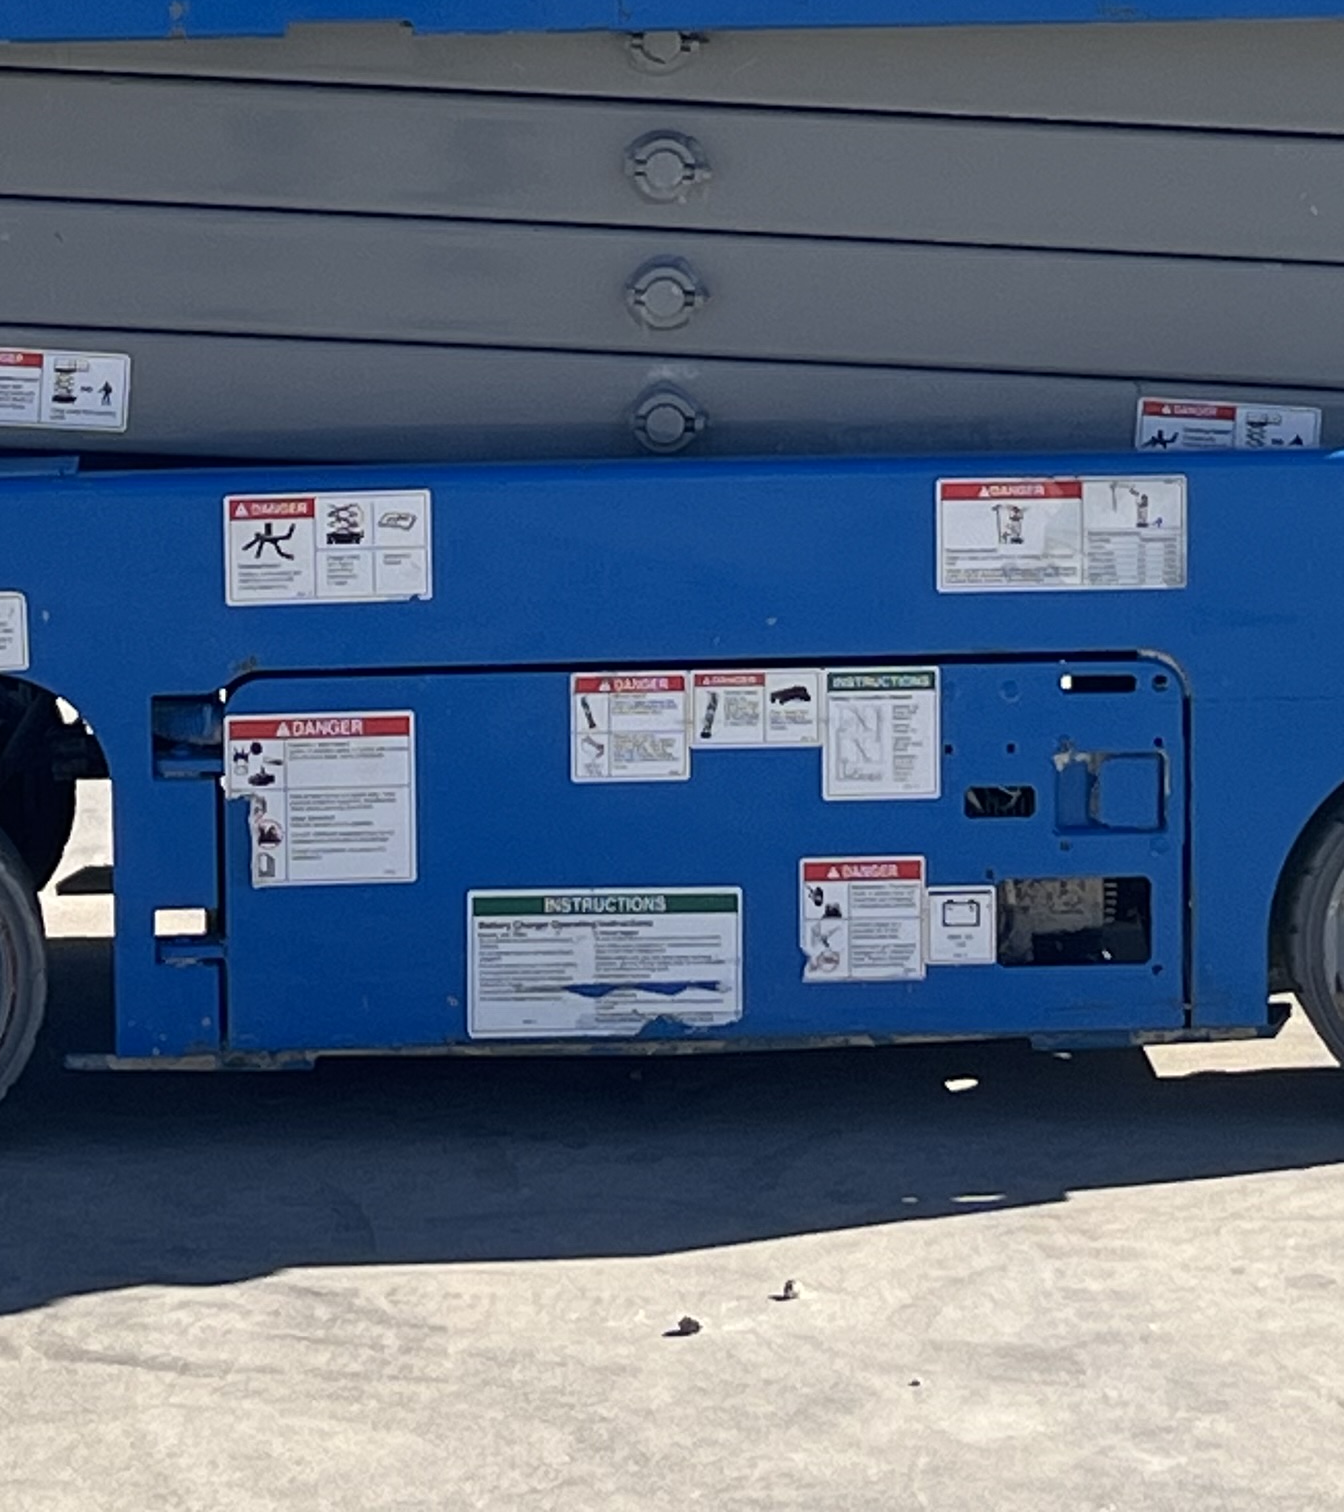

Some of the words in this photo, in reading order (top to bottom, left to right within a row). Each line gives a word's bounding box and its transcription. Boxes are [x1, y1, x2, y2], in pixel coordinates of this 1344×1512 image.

[250, 500, 308, 517] DANGER
[613, 677, 669, 693] DANGER
[292, 719, 364, 737] DANGER
[841, 864, 899, 879] DANGER
[543, 894, 667, 914] INSTRUCTIONS
